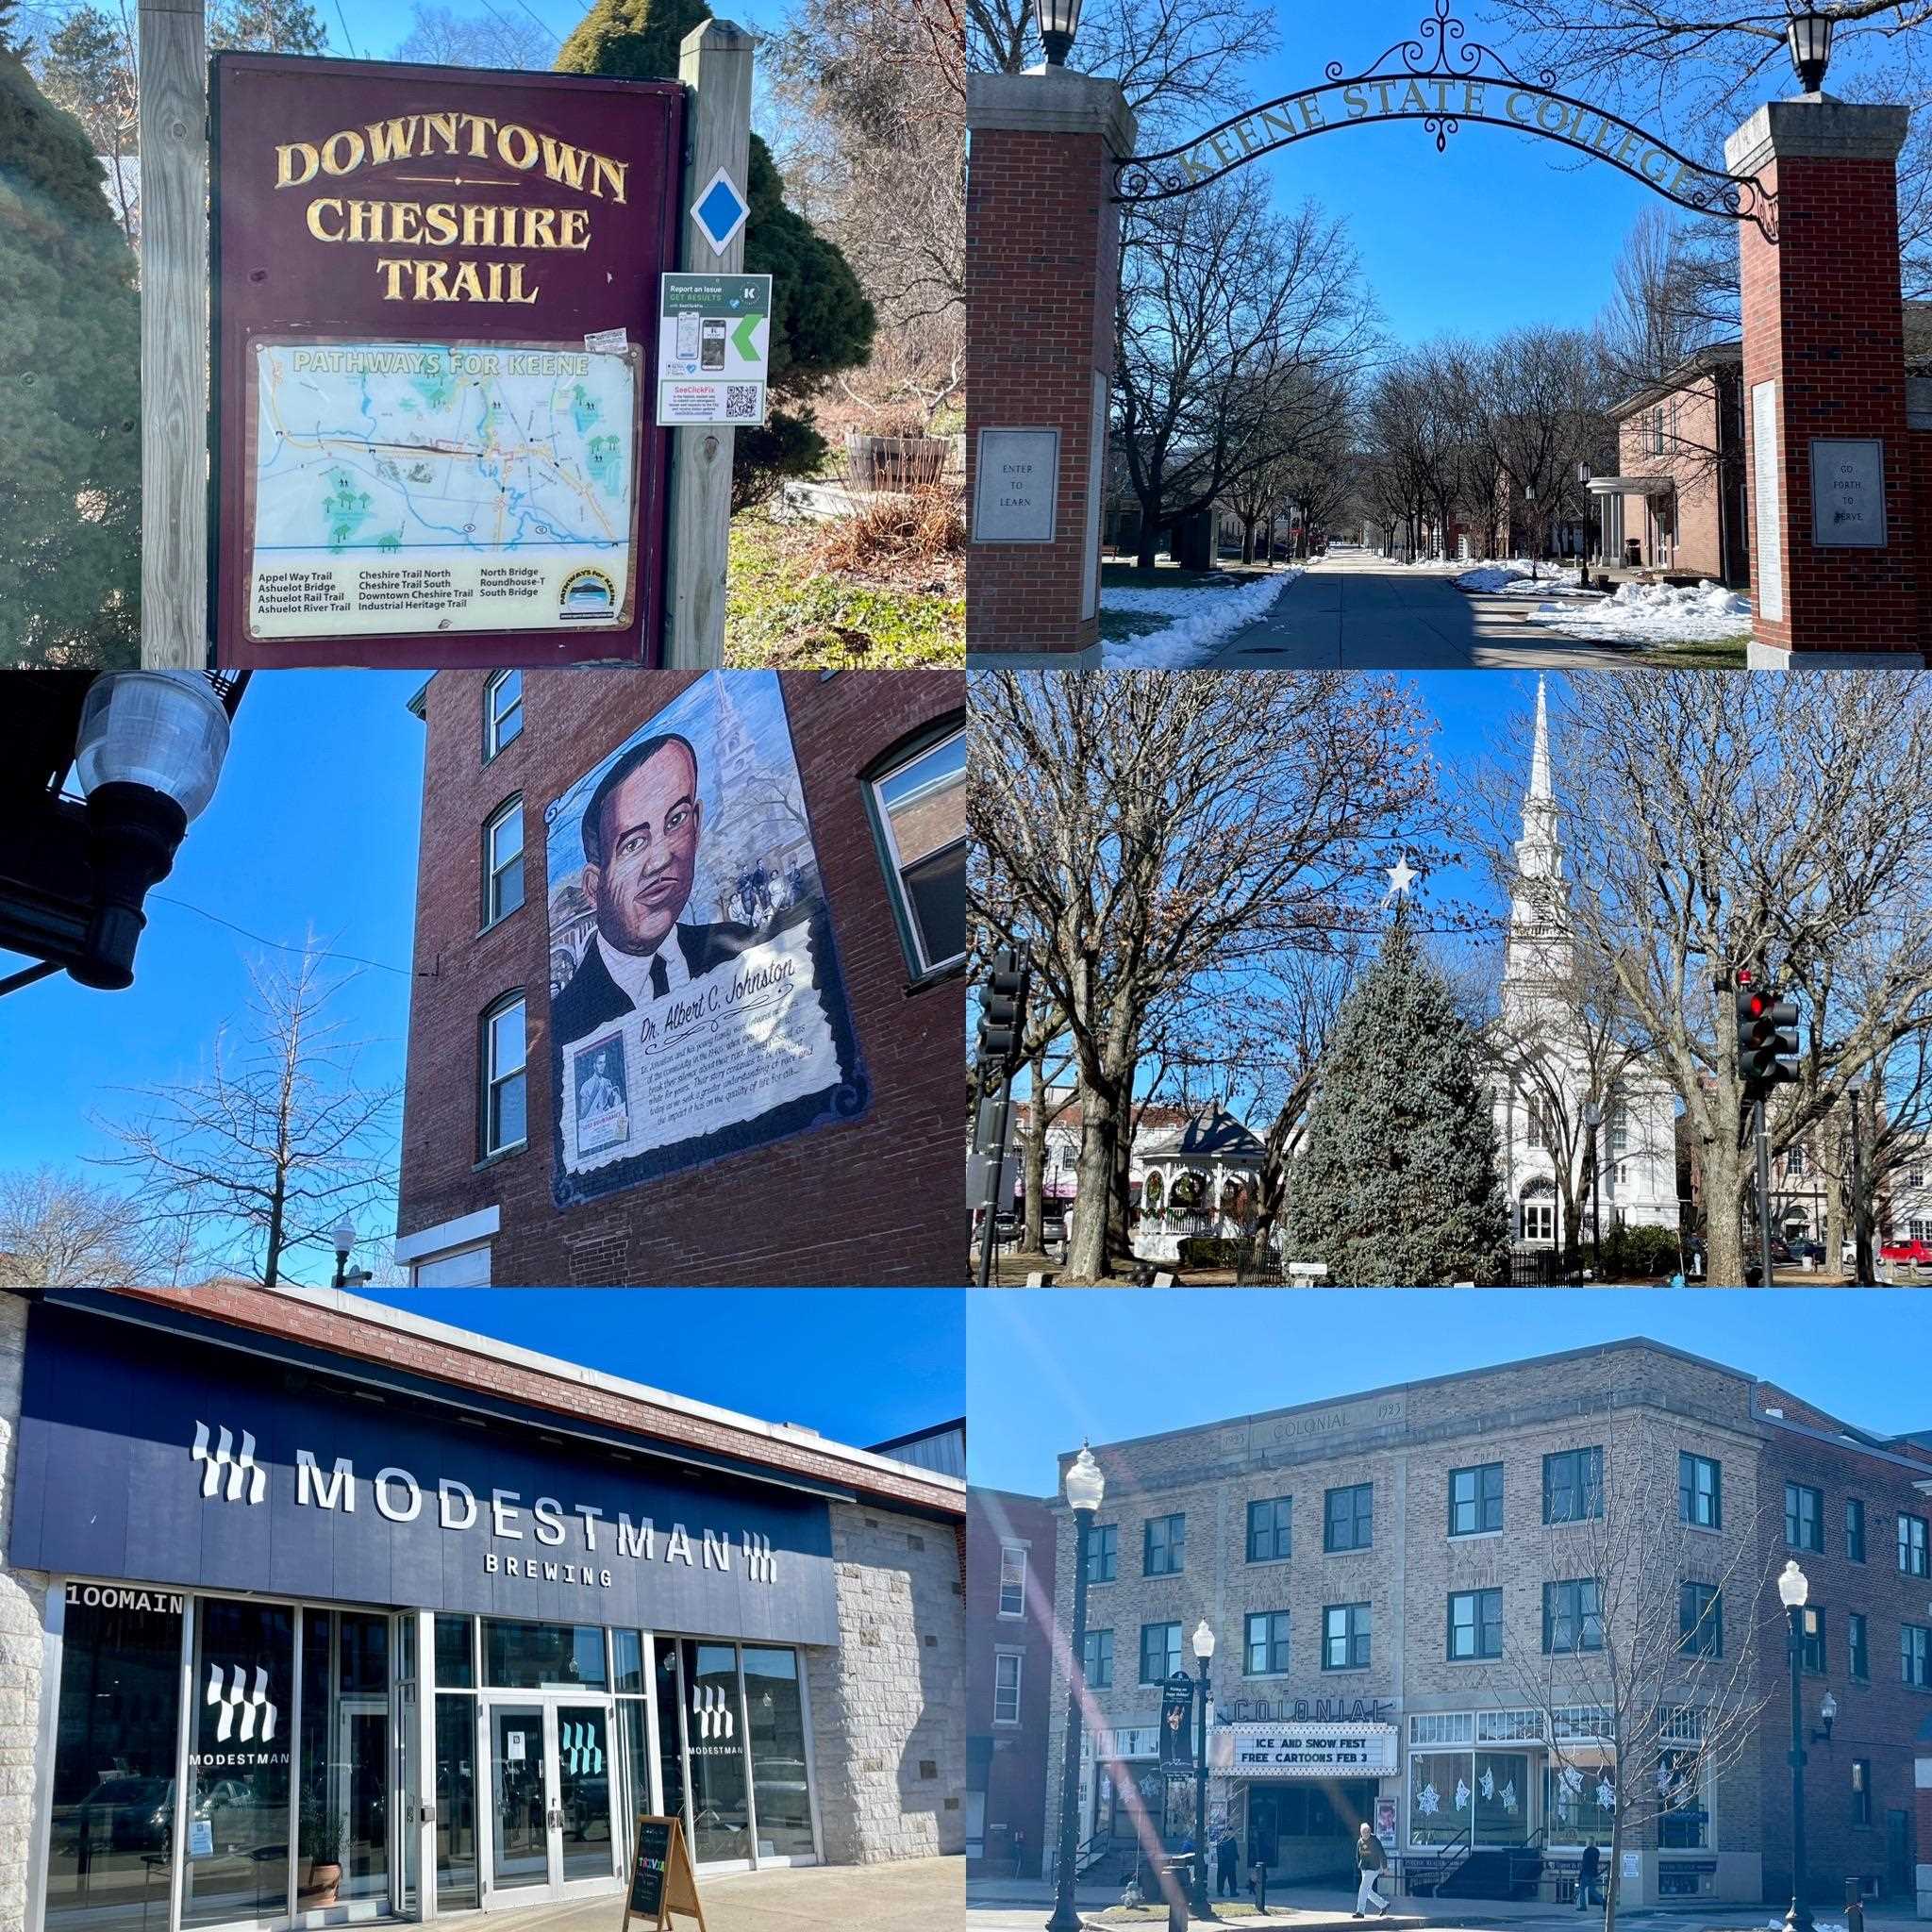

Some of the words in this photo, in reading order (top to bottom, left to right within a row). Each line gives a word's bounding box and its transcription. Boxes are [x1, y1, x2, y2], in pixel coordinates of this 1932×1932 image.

[1176, 92, 1326, 186] KEENE
[1342, 78, 1486, 120] STATE
[1506, 92, 1701, 194] COLLEGE
[274, 111, 629, 204] DOWNTOWN
[306, 197, 591, 251] CHESHIRE
[376, 258, 540, 304] TRAIL
[670, 285, 694, 293] Report
[687, 293, 722, 302] RESULTS
[293, 350, 441, 375] PATHWAYS
[450, 353, 501, 375] FOR
[508, 354, 590, 377] KEENE
[1003, 464, 1034, 474] ENTER
[1840, 465, 1853, 474] GO
[1011, 480, 1023, 490] TO
[1833, 481, 1861, 490] FORTH
[1000, 497, 1032, 507] LEARN
[1836, 512, 1864, 522] ERVE
[359, 570, 400, 579] Cheshire
[401, 570, 423, 578] Trail
[425, 569, 451, 578] North
[480, 568, 507, 576] North
[508, 567, 539, 576] Bridge
[258, 574, 287, 583] Appel
[290, 573, 309, 582] Way
[311, 572, 332, 581] Trail
[480, 576, 545, 587] Roundhouse-T
[258, 583, 302, 592] Ashuelot
[304, 582, 336, 592] Bridge
[358, 580, 400, 590] Cheshire
[401, 579, 423, 589] Trail
[424, 579, 451, 589] South
[559, 570, 591, 606] PATHWAYS
[604, 576, 617, 607] KEENE
[258, 593, 302, 603] Ashuelot
[304, 593, 322, 602] Rail
[324, 592, 344, 602] Trail
[358, 591, 410, 601] Downtown
[411, 590, 452, 599] Cheshire
[454, 589, 474, 597] Trail
[479, 589, 507, 597] South
[508, 588, 539, 597] Bridge
[258, 604, 302, 614] Ashuelot
[304, 604, 328, 612] River
[329, 603, 351, 612] Trail
[358, 601, 404, 610] Industrial
[405, 600, 445, 610] Heritage
[447, 599, 467, 608] Trail
[641, 1018, 660, 1042] Dr.
[664, 992, 706, 1032] Albert
[708, 984, 721, 1012] C.
[725, 958, 795, 1004] Johnston
[1378, 1402, 1401, 1419] 1923
[1274, 1413, 1350, 1440] COLONIAL
[295, 1448, 731, 1574] MODESTMAN
[484, 1553, 612, 1588] BREWING
[1234, 1699, 1387, 1723] COLONIAL
[1256, 1739, 1274, 1748] ICE
[1281, 1739, 1303, 1748] AND
[1306, 1739, 1336, 1748] SNOW
[1340, 1739, 1366, 1748] FEST
[688, 1746, 743, 1756] MODESTMAN
[189, 1752, 291, 1767] MODESTMAN
[1241, 1752, 1269, 1762] FREE
[1275, 1753, 1333, 1763] CARTOONS
[1337, 1753, 1357, 1762] FEB
[1360, 1753, 1368, 1762] 3
